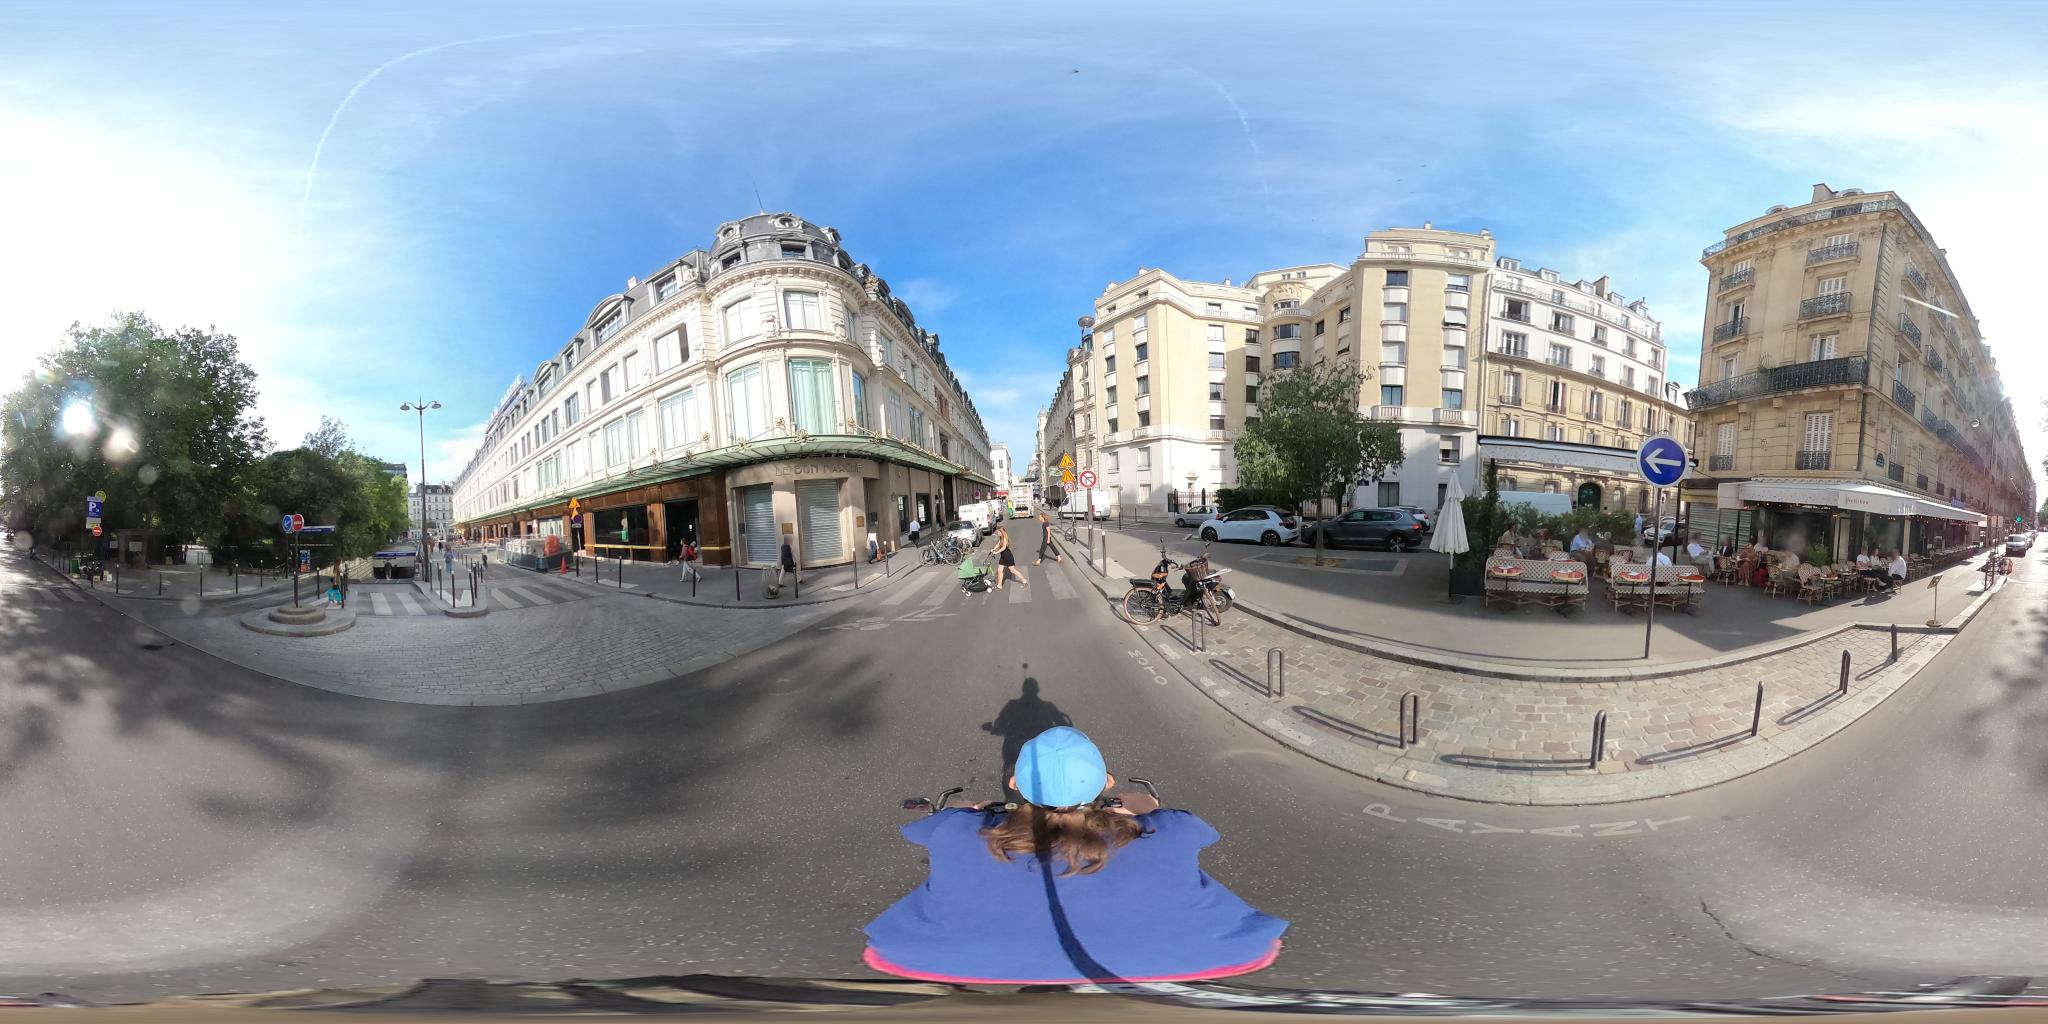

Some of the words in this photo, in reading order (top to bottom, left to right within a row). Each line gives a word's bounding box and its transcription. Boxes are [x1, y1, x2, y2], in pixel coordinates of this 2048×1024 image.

[775, 464, 792, 476] LE
[794, 463, 818, 474] BON
[88, 502, 97, 511] P
[1127, 649, 1168, 686] MOTO
[1362, 802, 1691, 838] PAYANT
